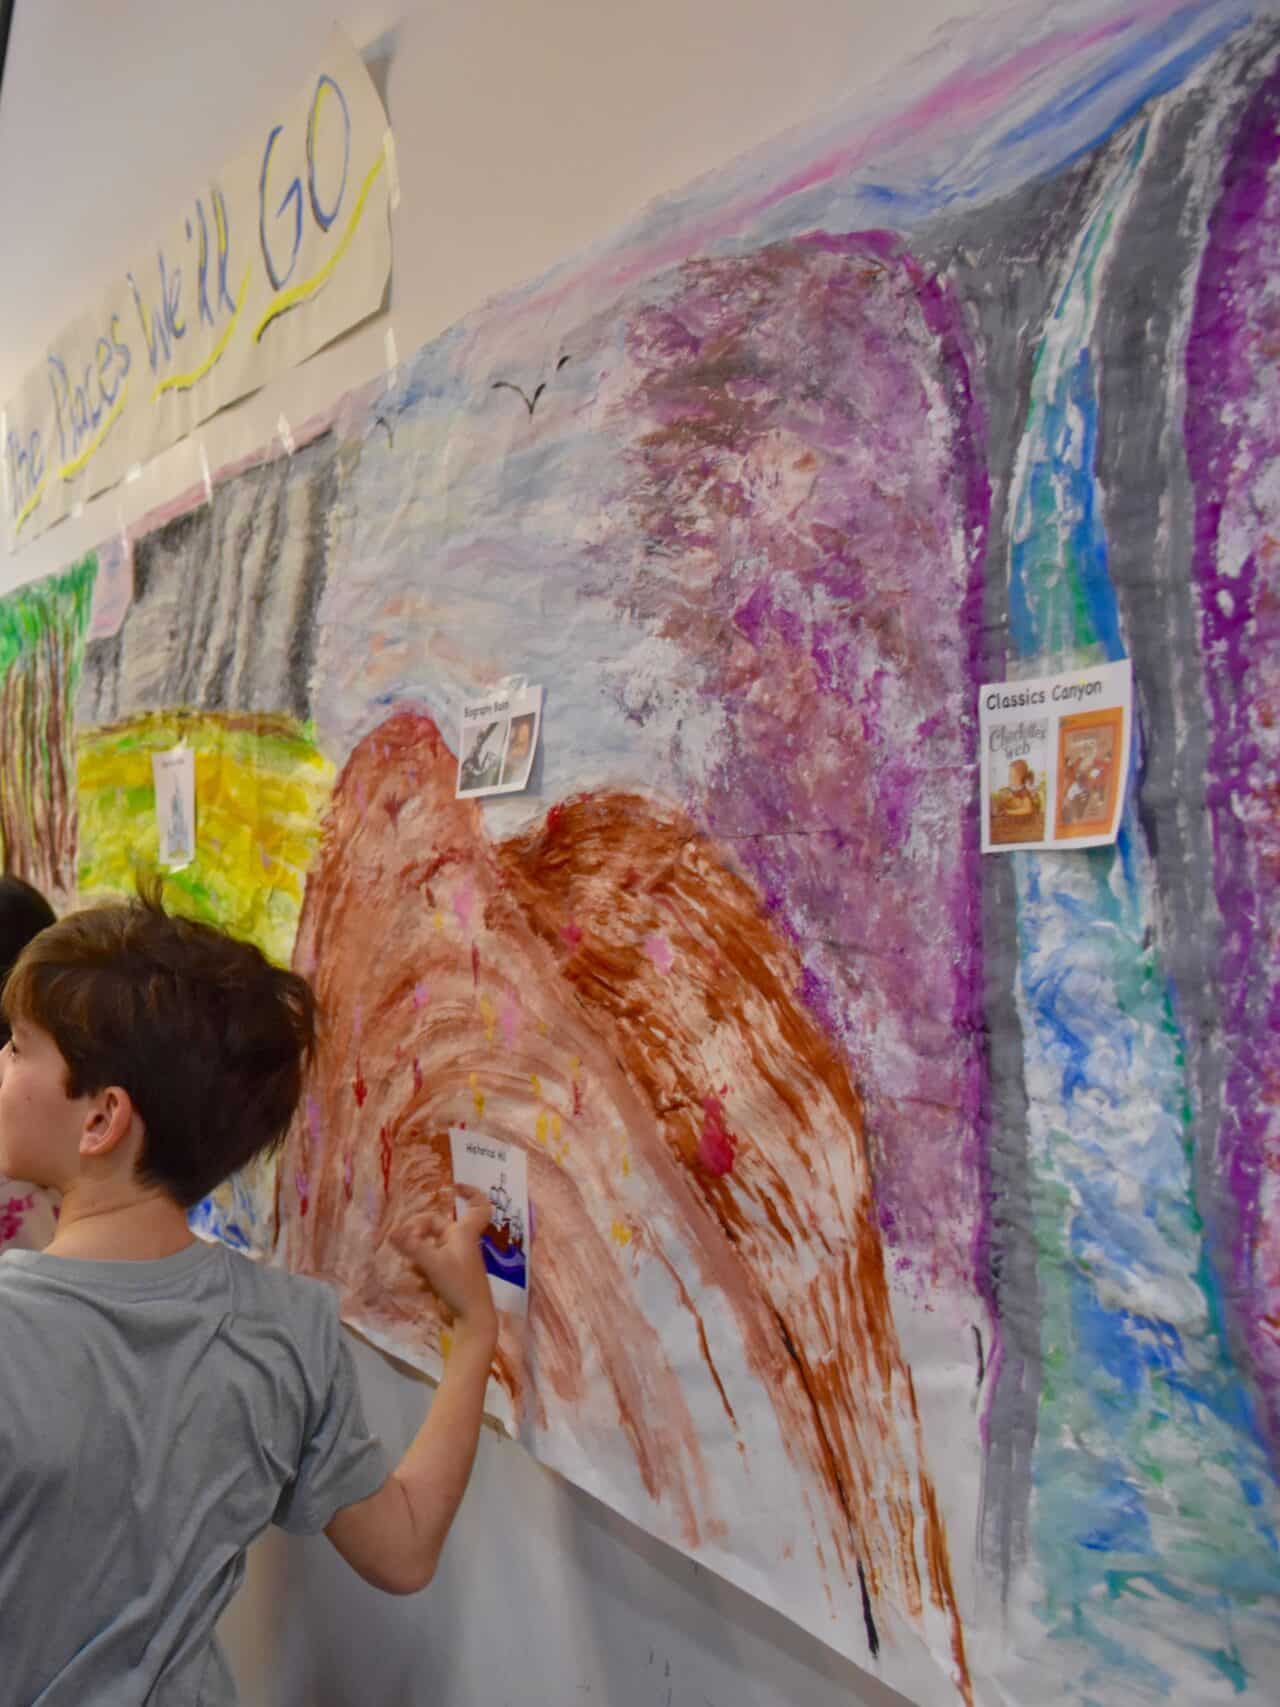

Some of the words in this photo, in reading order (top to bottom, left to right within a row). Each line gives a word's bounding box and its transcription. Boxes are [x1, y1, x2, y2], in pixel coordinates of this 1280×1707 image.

[48, 313, 131, 459] Places
[986, 688, 1046, 711] Classics
[1051, 680, 1103, 703] Canyon
